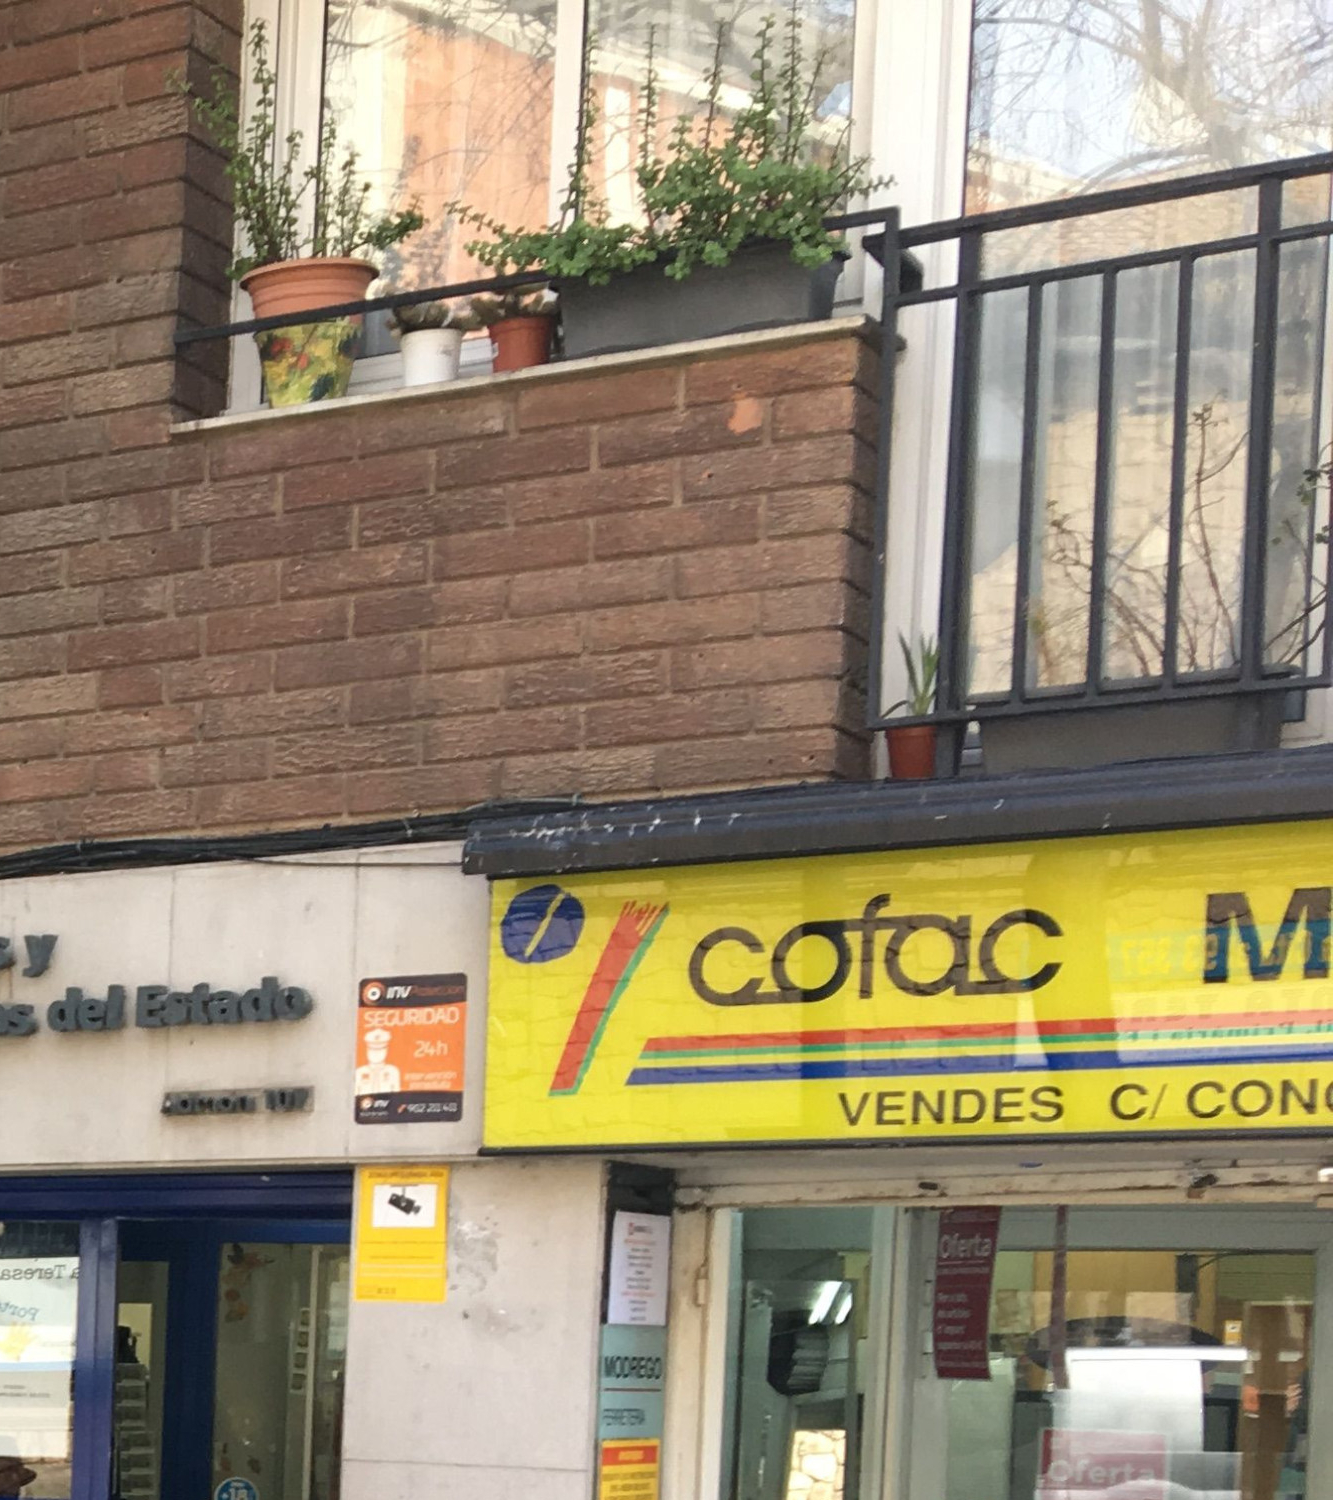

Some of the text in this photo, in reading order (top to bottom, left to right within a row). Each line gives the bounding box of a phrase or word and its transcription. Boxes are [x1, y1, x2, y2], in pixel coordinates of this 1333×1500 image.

[22, 934, 58, 978] y
[689, 893, 1064, 1007] cofac
[47, 984, 126, 1033] del
[136, 976, 314, 1028] Estado
[364, 1006, 460, 1027] SEGURIDAD
[413, 1040, 448, 1058] 24h
[838, 1085, 1064, 1126] VENDES
[1110, 1082, 1167, 1122] C/
[941, 1233, 992, 1259] Oferta
[604, 1356, 662, 1379] MODREGO
[1048, 1459, 1156, 1483] Oferta
